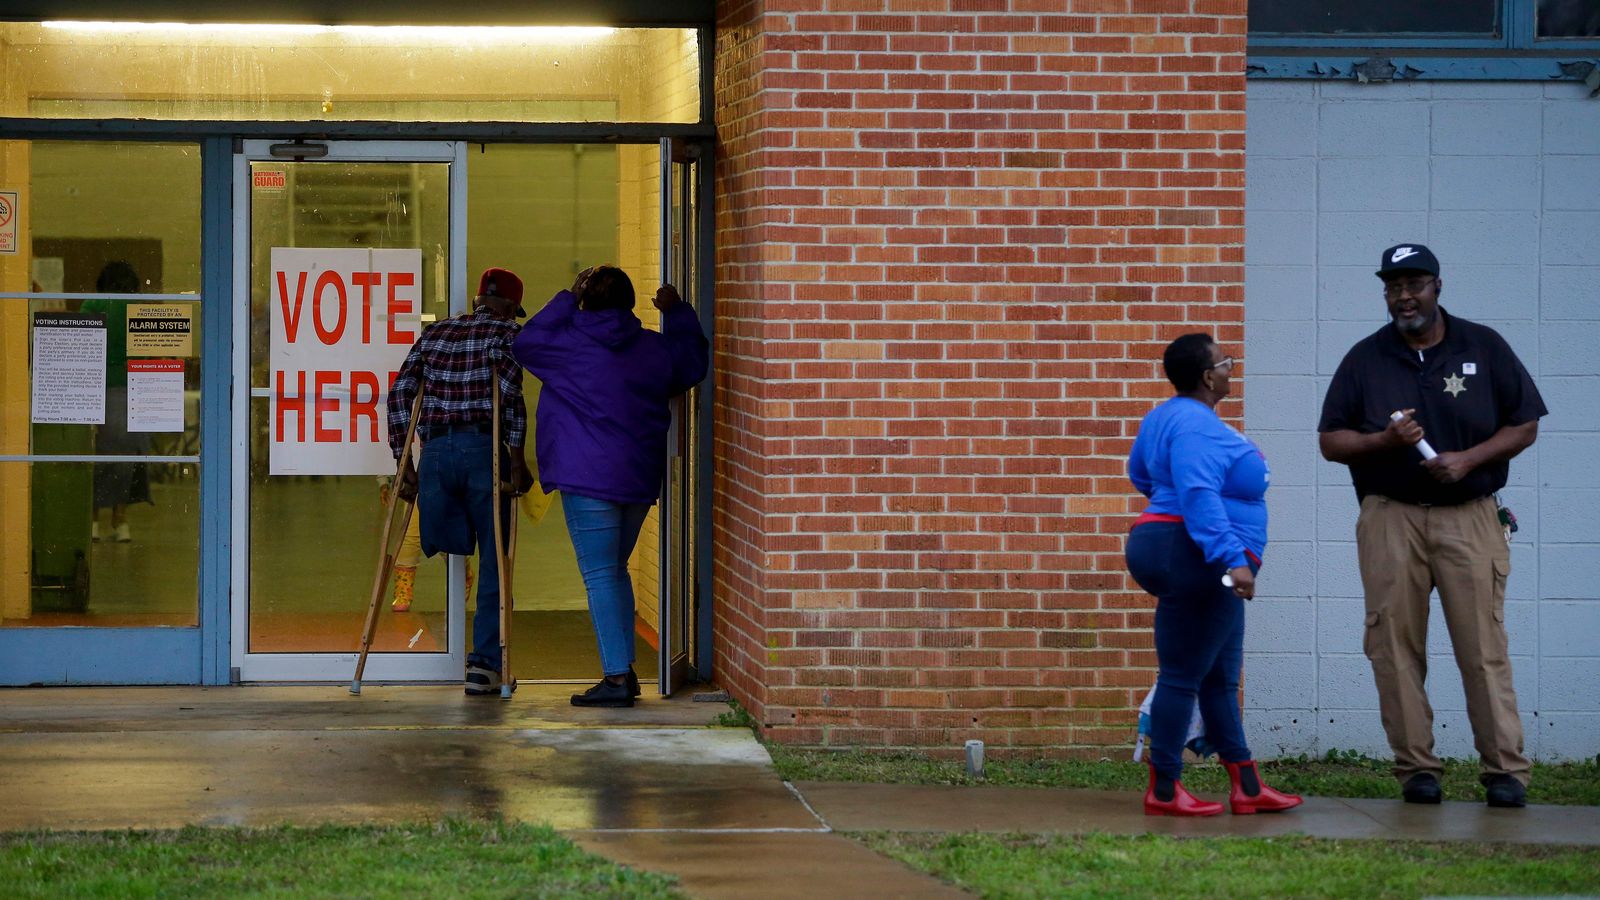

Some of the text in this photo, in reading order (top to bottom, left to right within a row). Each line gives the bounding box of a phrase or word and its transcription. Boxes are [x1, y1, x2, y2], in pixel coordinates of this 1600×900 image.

[254, 176, 284, 186] GUARD
[276, 270, 414, 345] VOTE
[160, 322, 190, 330] SYSTEM
